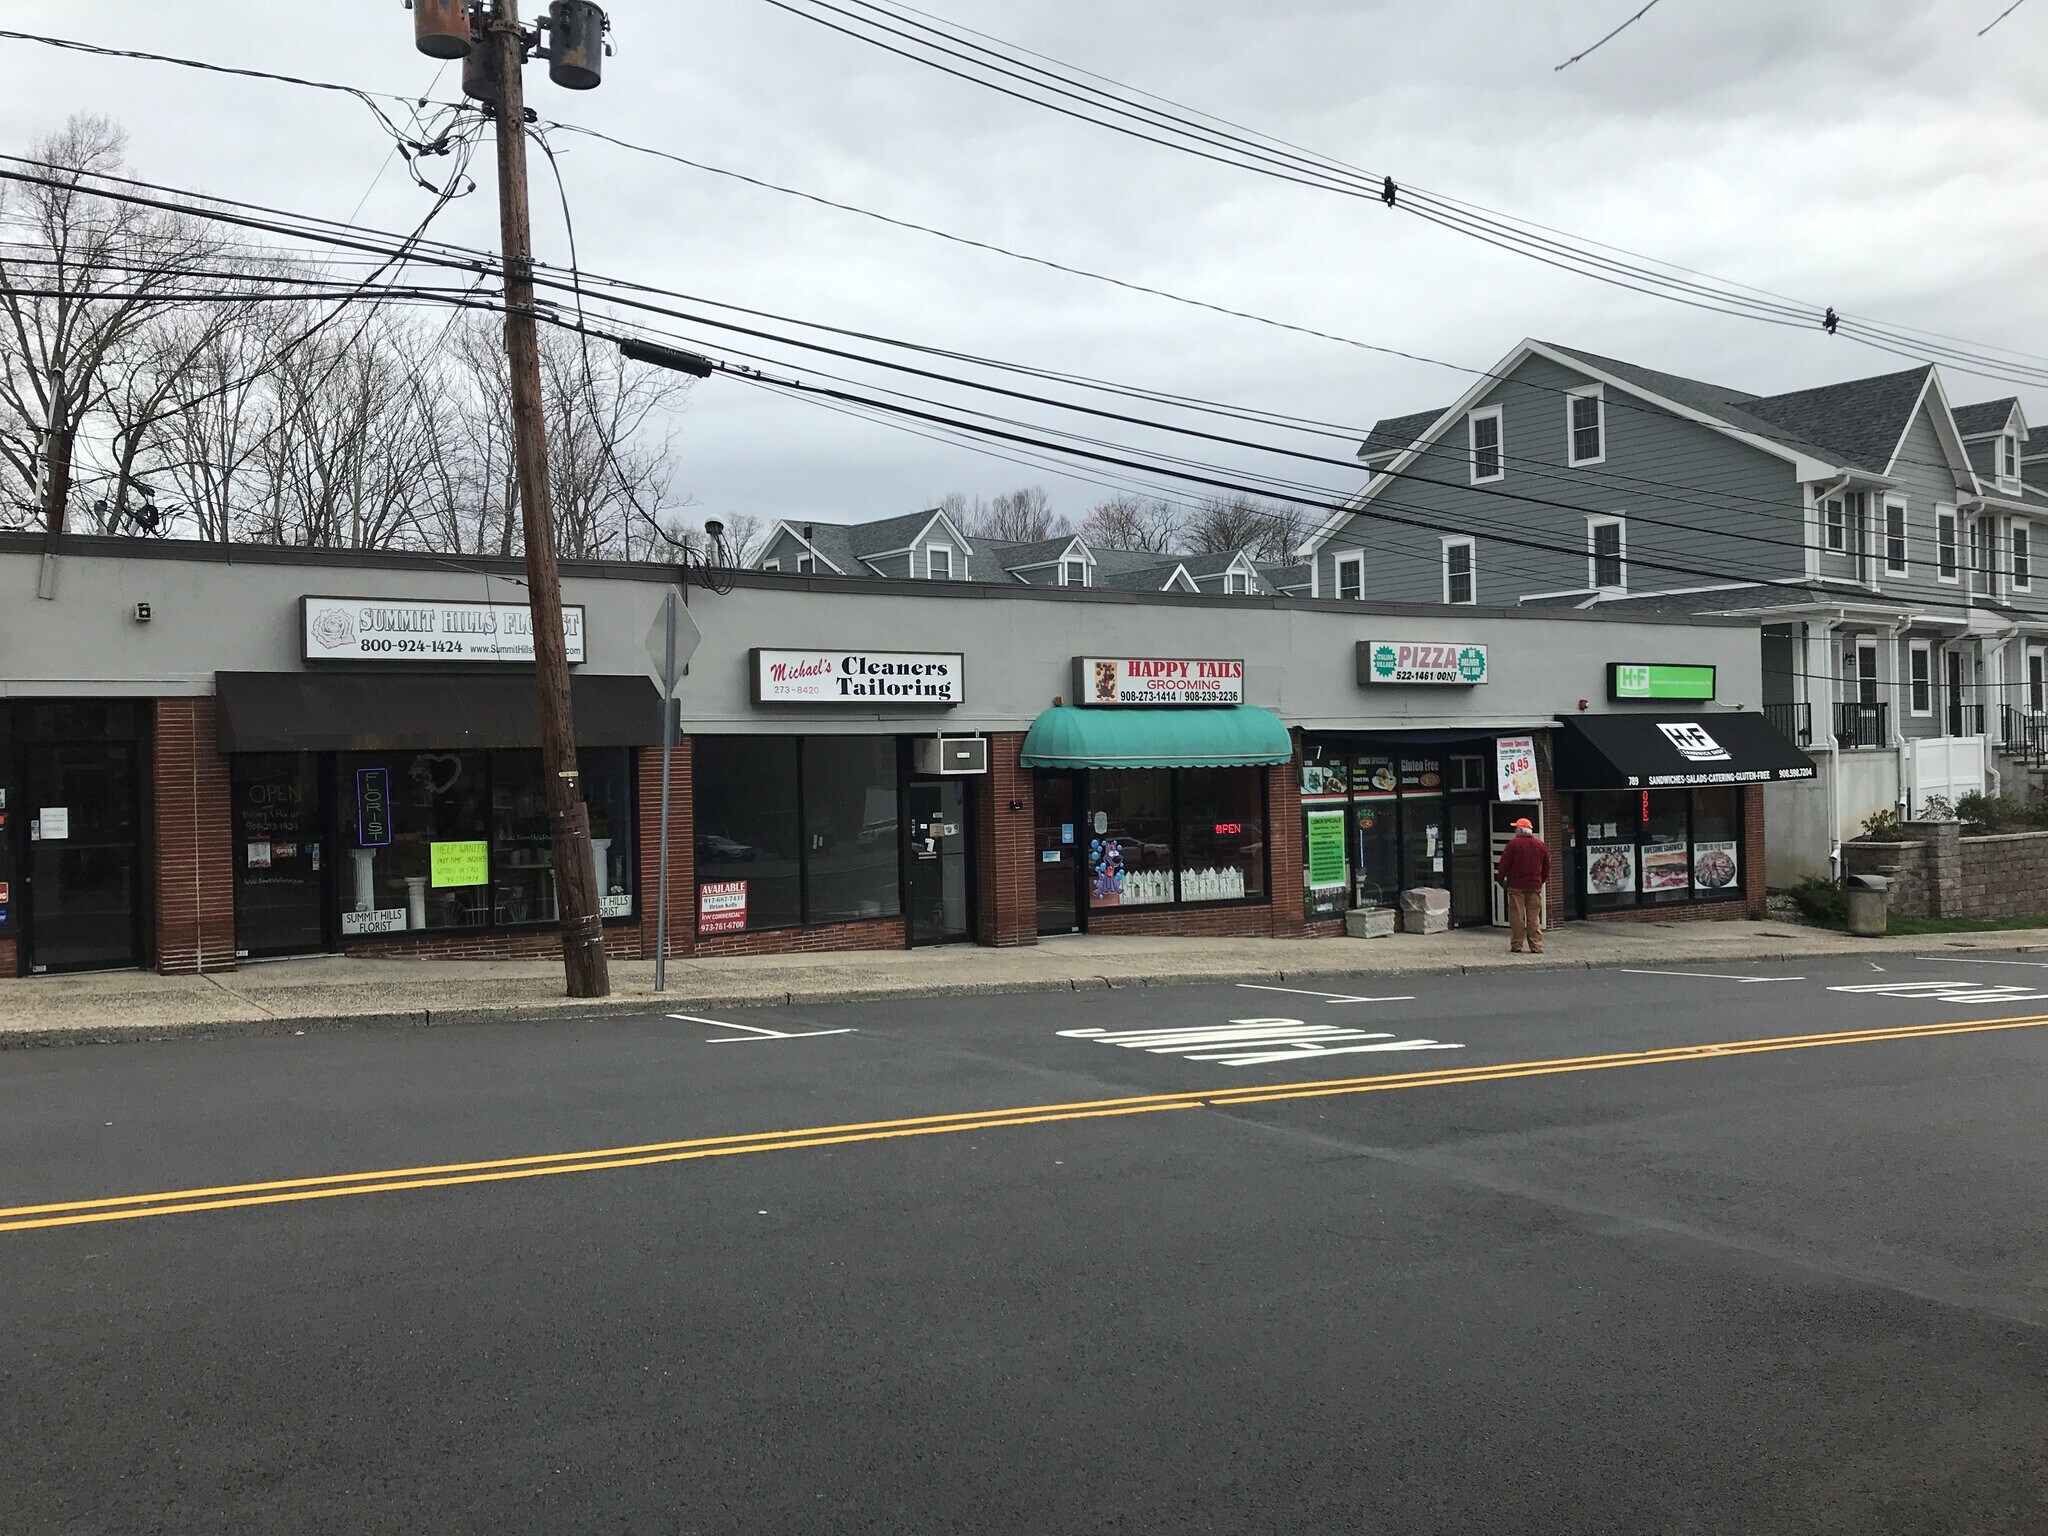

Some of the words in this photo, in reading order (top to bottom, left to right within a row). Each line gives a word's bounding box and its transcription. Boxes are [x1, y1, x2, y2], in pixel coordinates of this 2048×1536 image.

[359, 607, 436, 633] SUMMIT
[441, 610, 498, 635] HILLS
[360, 638, 463, 653] 800-924-1424
[1398, 646, 1458, 669] PIZZA
[1460, 658, 1480, 667] DELIVER
[770, 658, 832, 682] Michael's
[841, 656, 948, 676] Cleaners
[1128, 660, 1190, 678] HAPPY
[1197, 662, 1242, 678] TAILS
[1462, 667, 1471, 675] ALL
[1472, 666, 1481, 675] DAY
[774, 686, 820, 695] 273-8420
[836, 676, 951, 701] Tailoring
[1146, 680, 1220, 690] GROOMING
[1120, 690, 1176, 702] 908-273-1414
[1184, 690, 1238, 702] 908-239-2236
[1400, 760, 1424, 772] Gluten
[1424, 760, 1439, 772] Free
[1504, 757, 1528, 778] $9.95
[1627, 776, 1640, 786] 789
[249, 784, 302, 804] OPEN
[364, 772, 382, 841] FLORIST
[437, 844, 456, 854] HELP
[460, 843, 486, 854] WANTED
[1614, 845, 1630, 853] SALAD
[1644, 846, 1663, 854] AWESOME
[1663, 843, 1684, 852] SANDWICH
[702, 882, 746, 894] AVAILABLE
[609, 896, 628, 906] HILLS
[346, 911, 379, 924] SUMMIT
[380, 910, 402, 920] HILLS
[712, 912, 741, 920] COMMERCIAL
[360, 920, 392, 933] FLORIST
[701, 921, 744, 932] 973-761-6700
